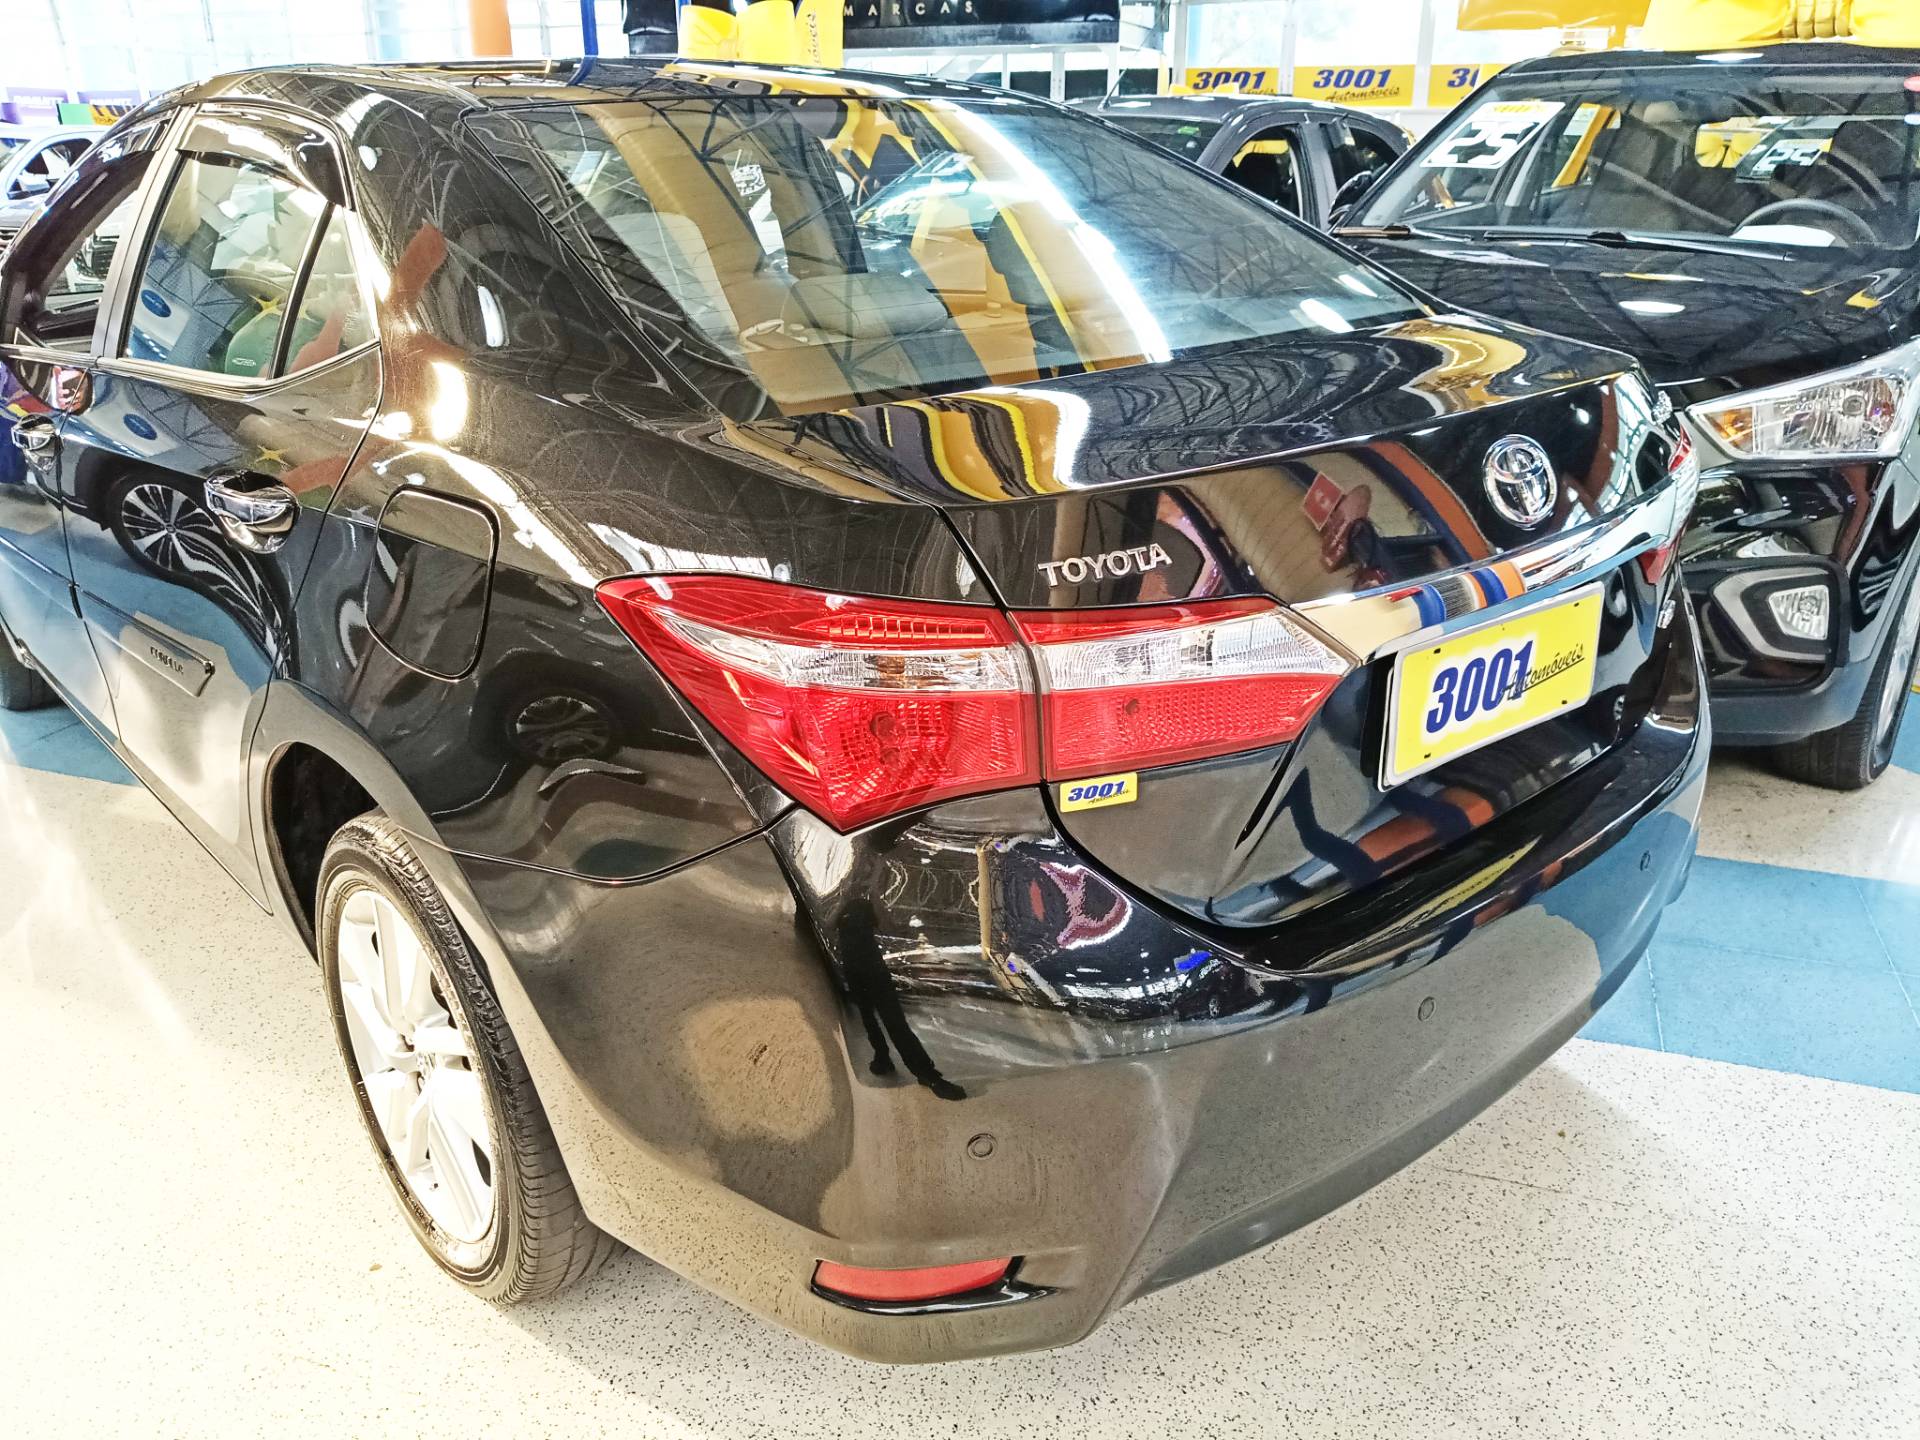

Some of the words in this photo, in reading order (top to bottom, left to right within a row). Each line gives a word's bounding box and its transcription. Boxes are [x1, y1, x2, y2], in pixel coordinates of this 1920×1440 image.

[843, 1, 973, 17] MARCAS
[1313, 69, 1391, 88] 3001
[1325, 86, 1400, 102] Automóveis
[1037, 542, 1173, 587] TOYOTA
[1499, 643, 1585, 703] Automóveis
[1426, 640, 1534, 734] 3001
[1067, 780, 1125, 802] 3001
